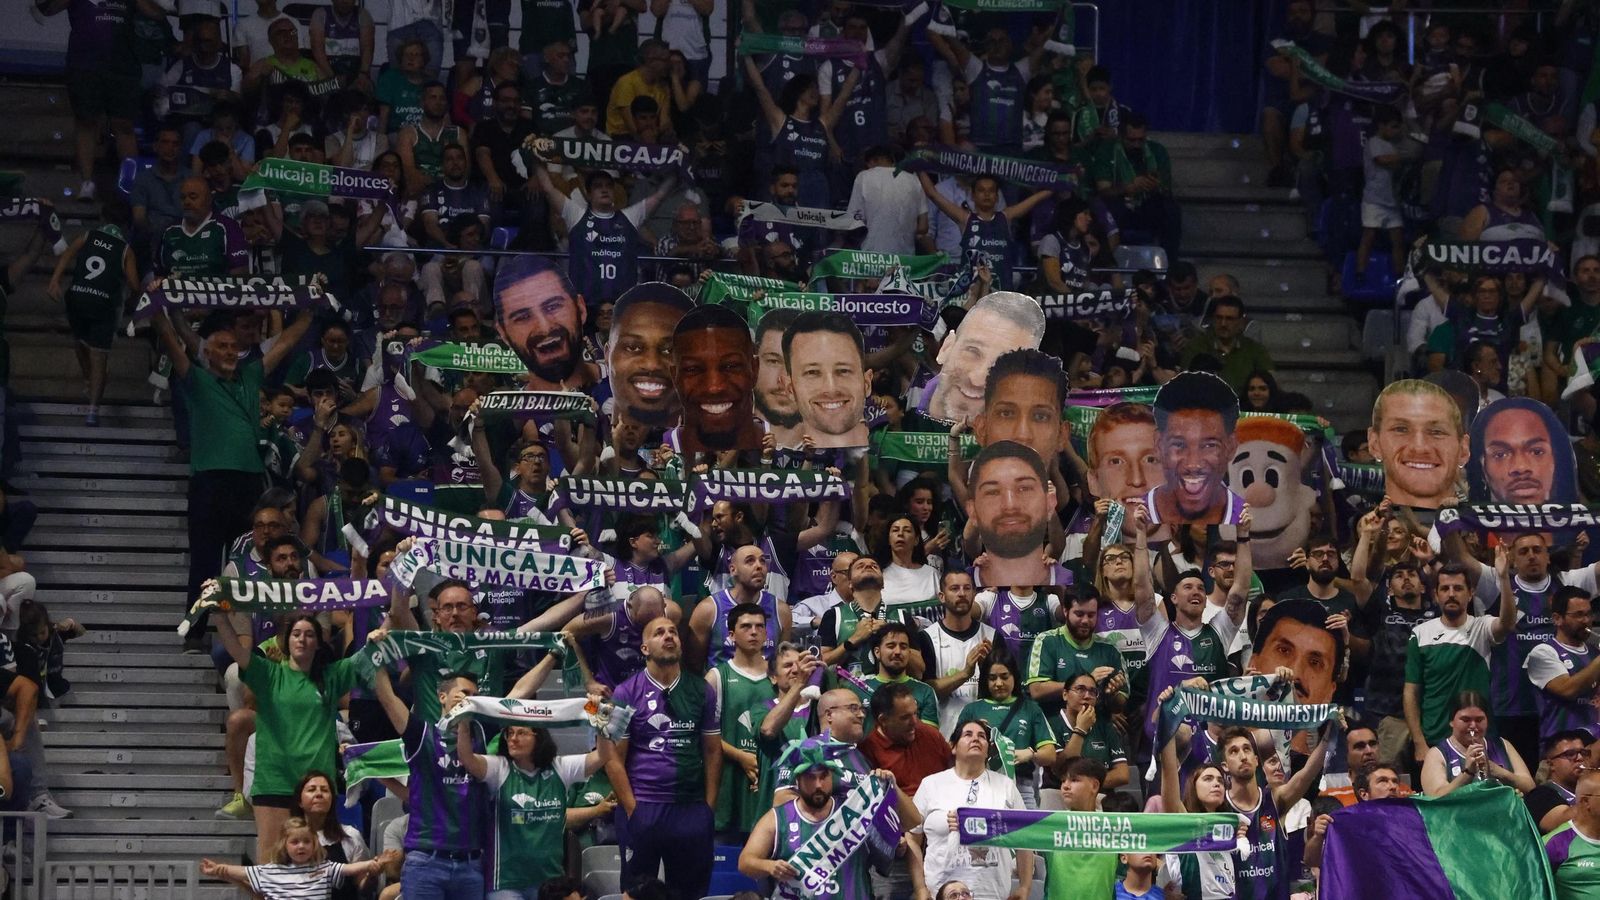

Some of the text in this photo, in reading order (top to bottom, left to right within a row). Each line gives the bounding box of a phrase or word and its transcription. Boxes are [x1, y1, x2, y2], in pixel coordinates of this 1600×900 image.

[854, 110, 866, 126] 6
[563, 140, 684, 167] UNICAJA
[940, 152, 987, 175] UNICAJA
[257, 163, 315, 186] Unicaja
[318, 169, 391, 191] Balonces
[0, 198, 41, 216] JA
[797, 211, 826, 223] Unicaja
[591, 249, 622, 259] málaga
[852, 253, 900, 265] UNICAJA
[1428, 244, 1556, 267] UNICAJA
[84, 256, 106, 281] 9
[598, 264, 617, 280] 10
[162, 279, 297, 306] UNICAJA
[818, 296, 911, 314] Baloncesto
[700, 468, 846, 499] UNICAJA
[384, 496, 542, 553] UNICAJA
[1471, 503, 1600, 528] UNICA
[445, 541, 579, 577] UNICAJA
[484, 568, 575, 591] MALAGA
[229, 578, 388, 604] UNICAJA
[524, 707, 553, 716] Unicaja
[1241, 703, 1329, 723] BALONCESTO
[669, 719, 696, 730] Unicaja
[116, 753, 123, 761] 8
[120, 796, 127, 804] 7
[534, 797, 561, 808] Unicaja
[1066, 815, 1133, 832] UNICAJA
[126, 842, 132, 850] 6
[1053, 831, 1147, 849] BALONCESTO
